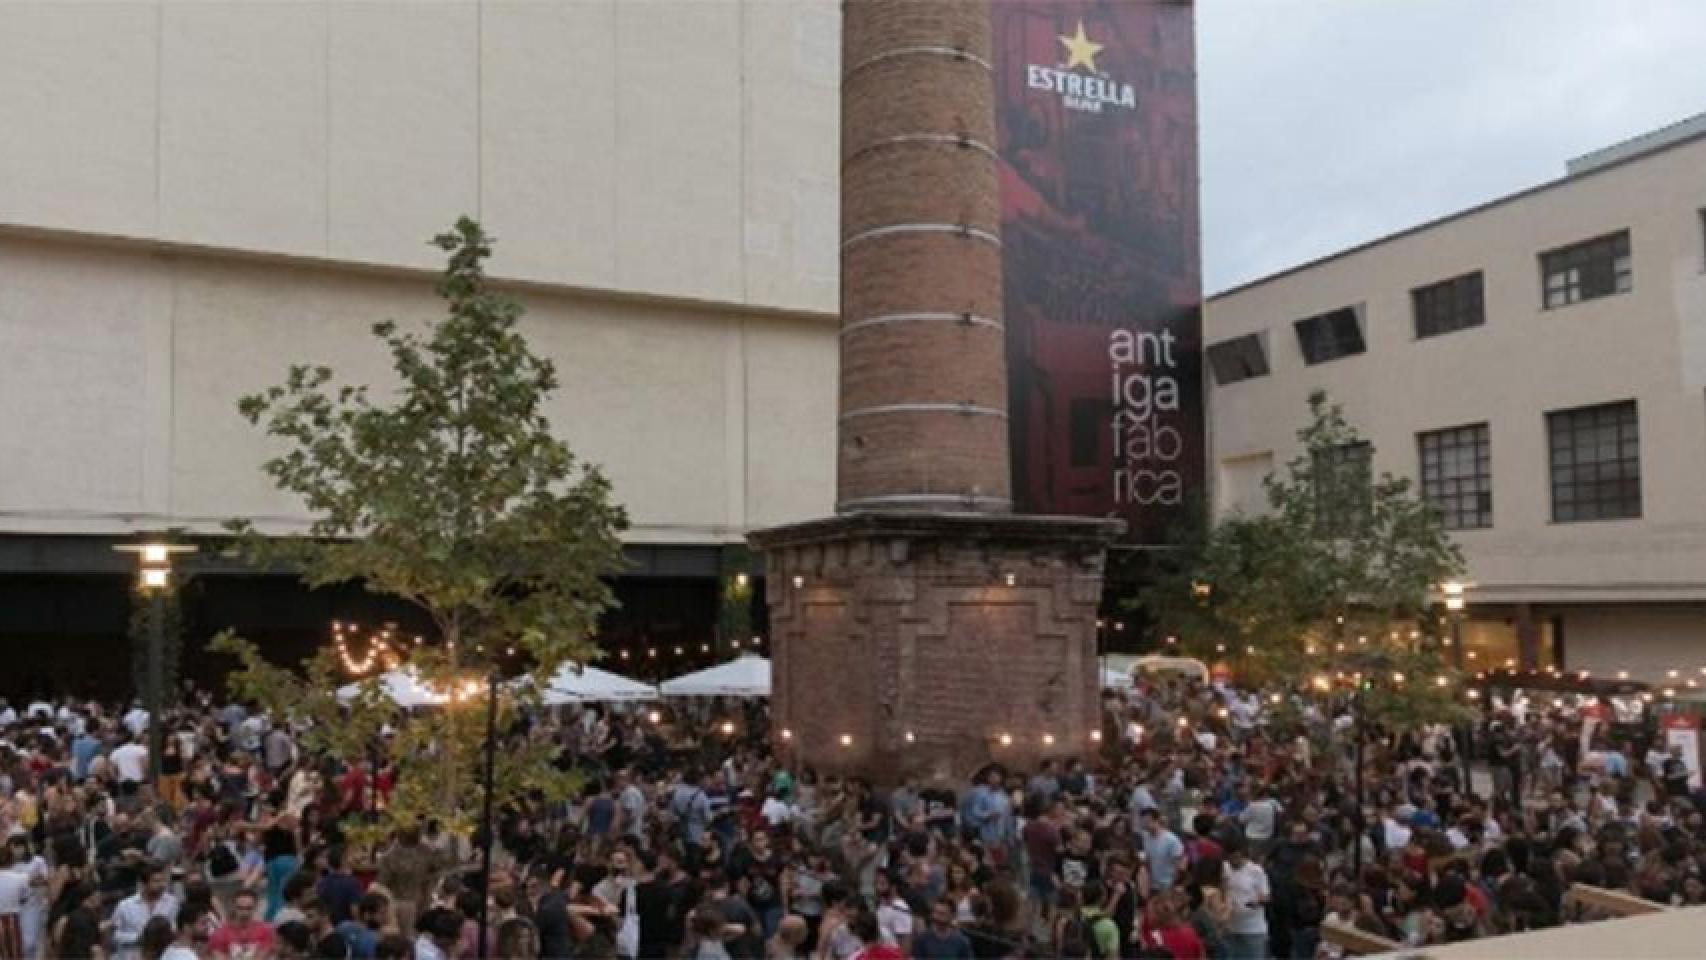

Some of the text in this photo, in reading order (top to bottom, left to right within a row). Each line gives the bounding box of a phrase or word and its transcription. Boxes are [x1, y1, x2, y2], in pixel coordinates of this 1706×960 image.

[1027, 64, 1136, 109] ESTRELLA
[1109, 328, 1177, 368] ant
[1112, 361, 1179, 422] iga
[1110, 409, 1183, 461] fab
[1112, 459, 1183, 505] rica
